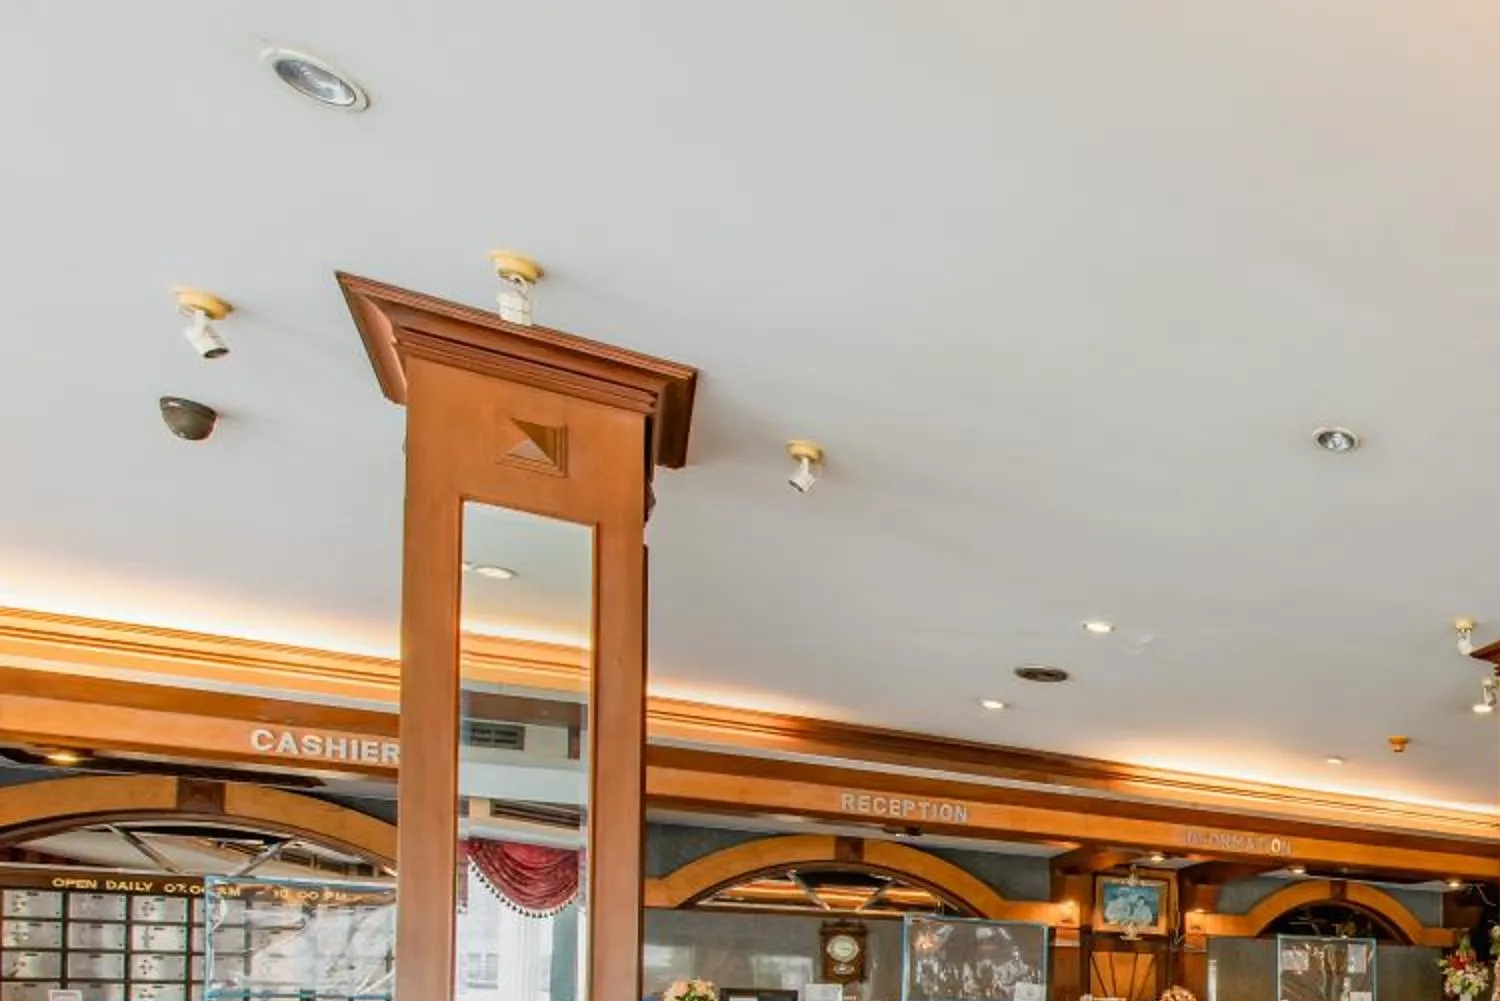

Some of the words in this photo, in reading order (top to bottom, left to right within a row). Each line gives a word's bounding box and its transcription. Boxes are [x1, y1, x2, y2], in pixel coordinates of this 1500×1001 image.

[251, 729, 400, 763] CASHIER
[841, 793, 968, 823] RECEPTION
[52, 877, 97, 889] OPEN
[105, 880, 153, 892] DAILY
